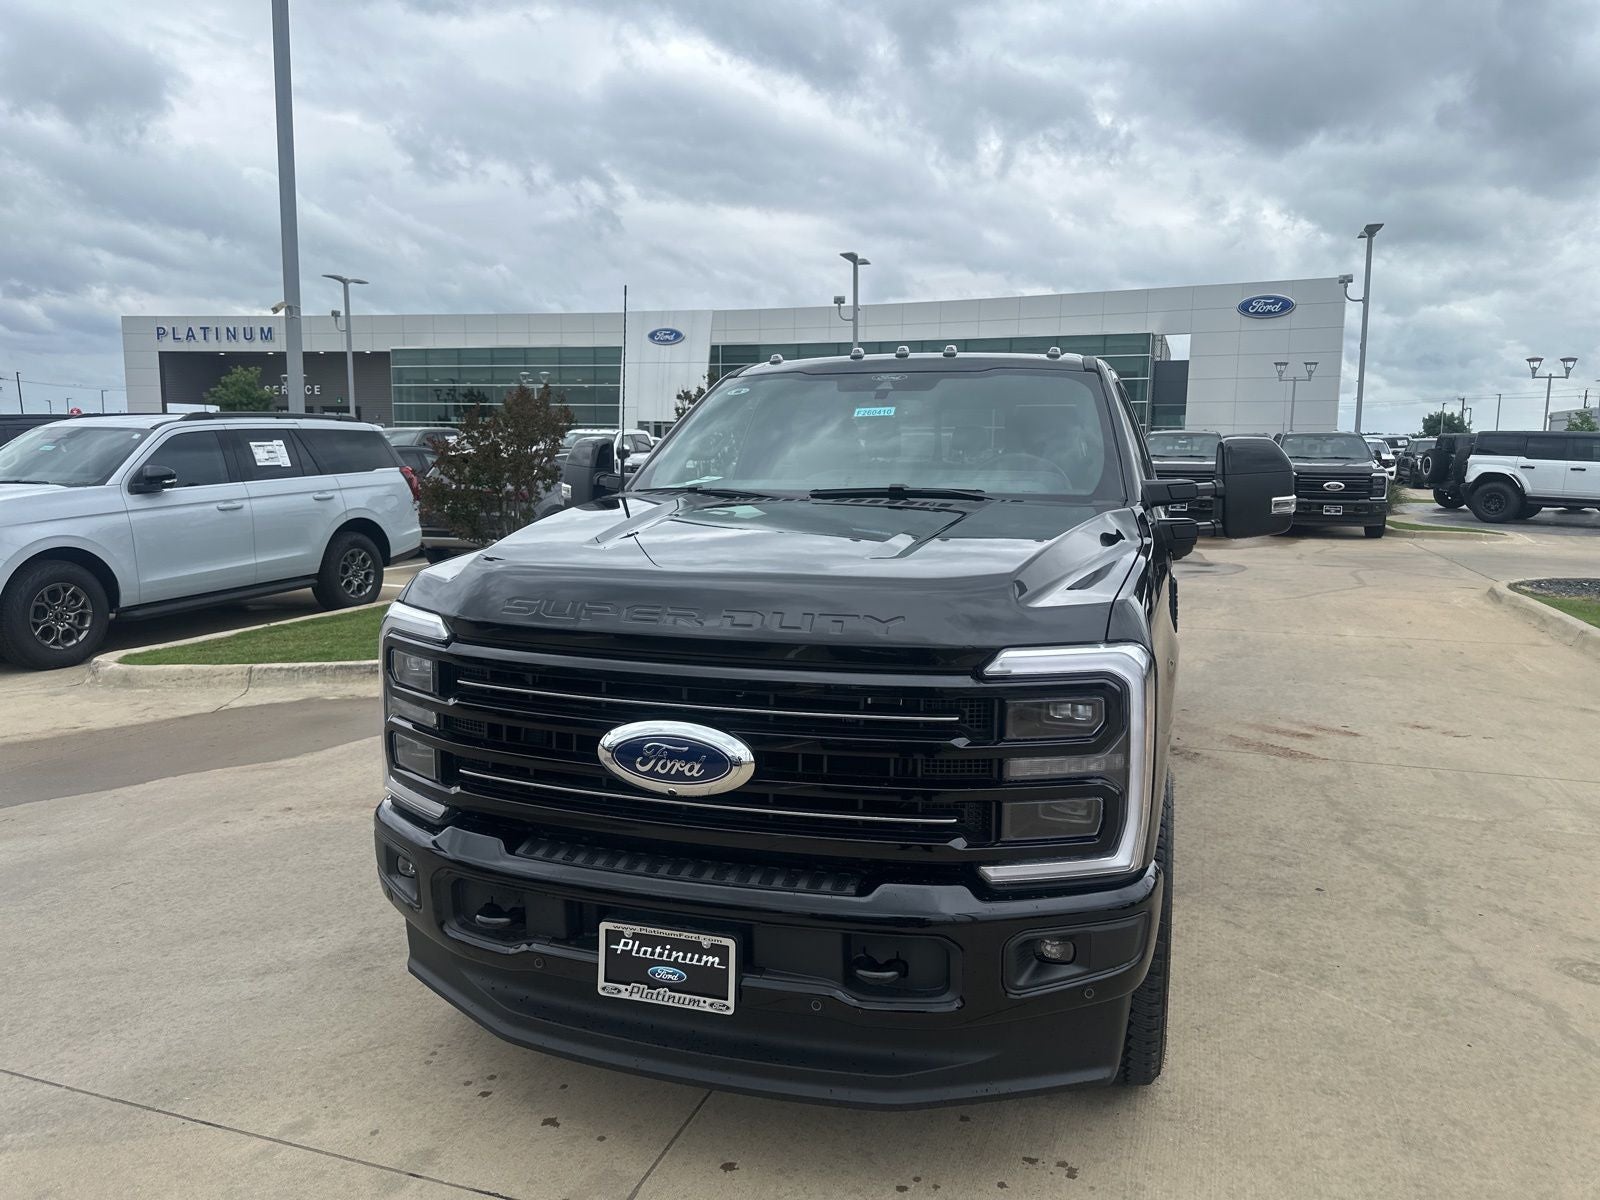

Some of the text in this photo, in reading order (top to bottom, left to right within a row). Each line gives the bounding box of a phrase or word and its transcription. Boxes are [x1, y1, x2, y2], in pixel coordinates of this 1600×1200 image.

[1248, 299, 1283, 313] Ford
[156, 326, 274, 341] PLATINUM
[654, 330, 676, 341] Ford
[264, 385, 321, 395] SERCE
[500, 595, 906, 636] SUPER DUTY
[635, 742, 707, 777] Ford
[612, 924, 723, 944] www.PlatinumFord.com
[610, 938, 726, 969] Platinum
[655, 967, 679, 981] Ford
[628, 983, 705, 1008] Platinum
